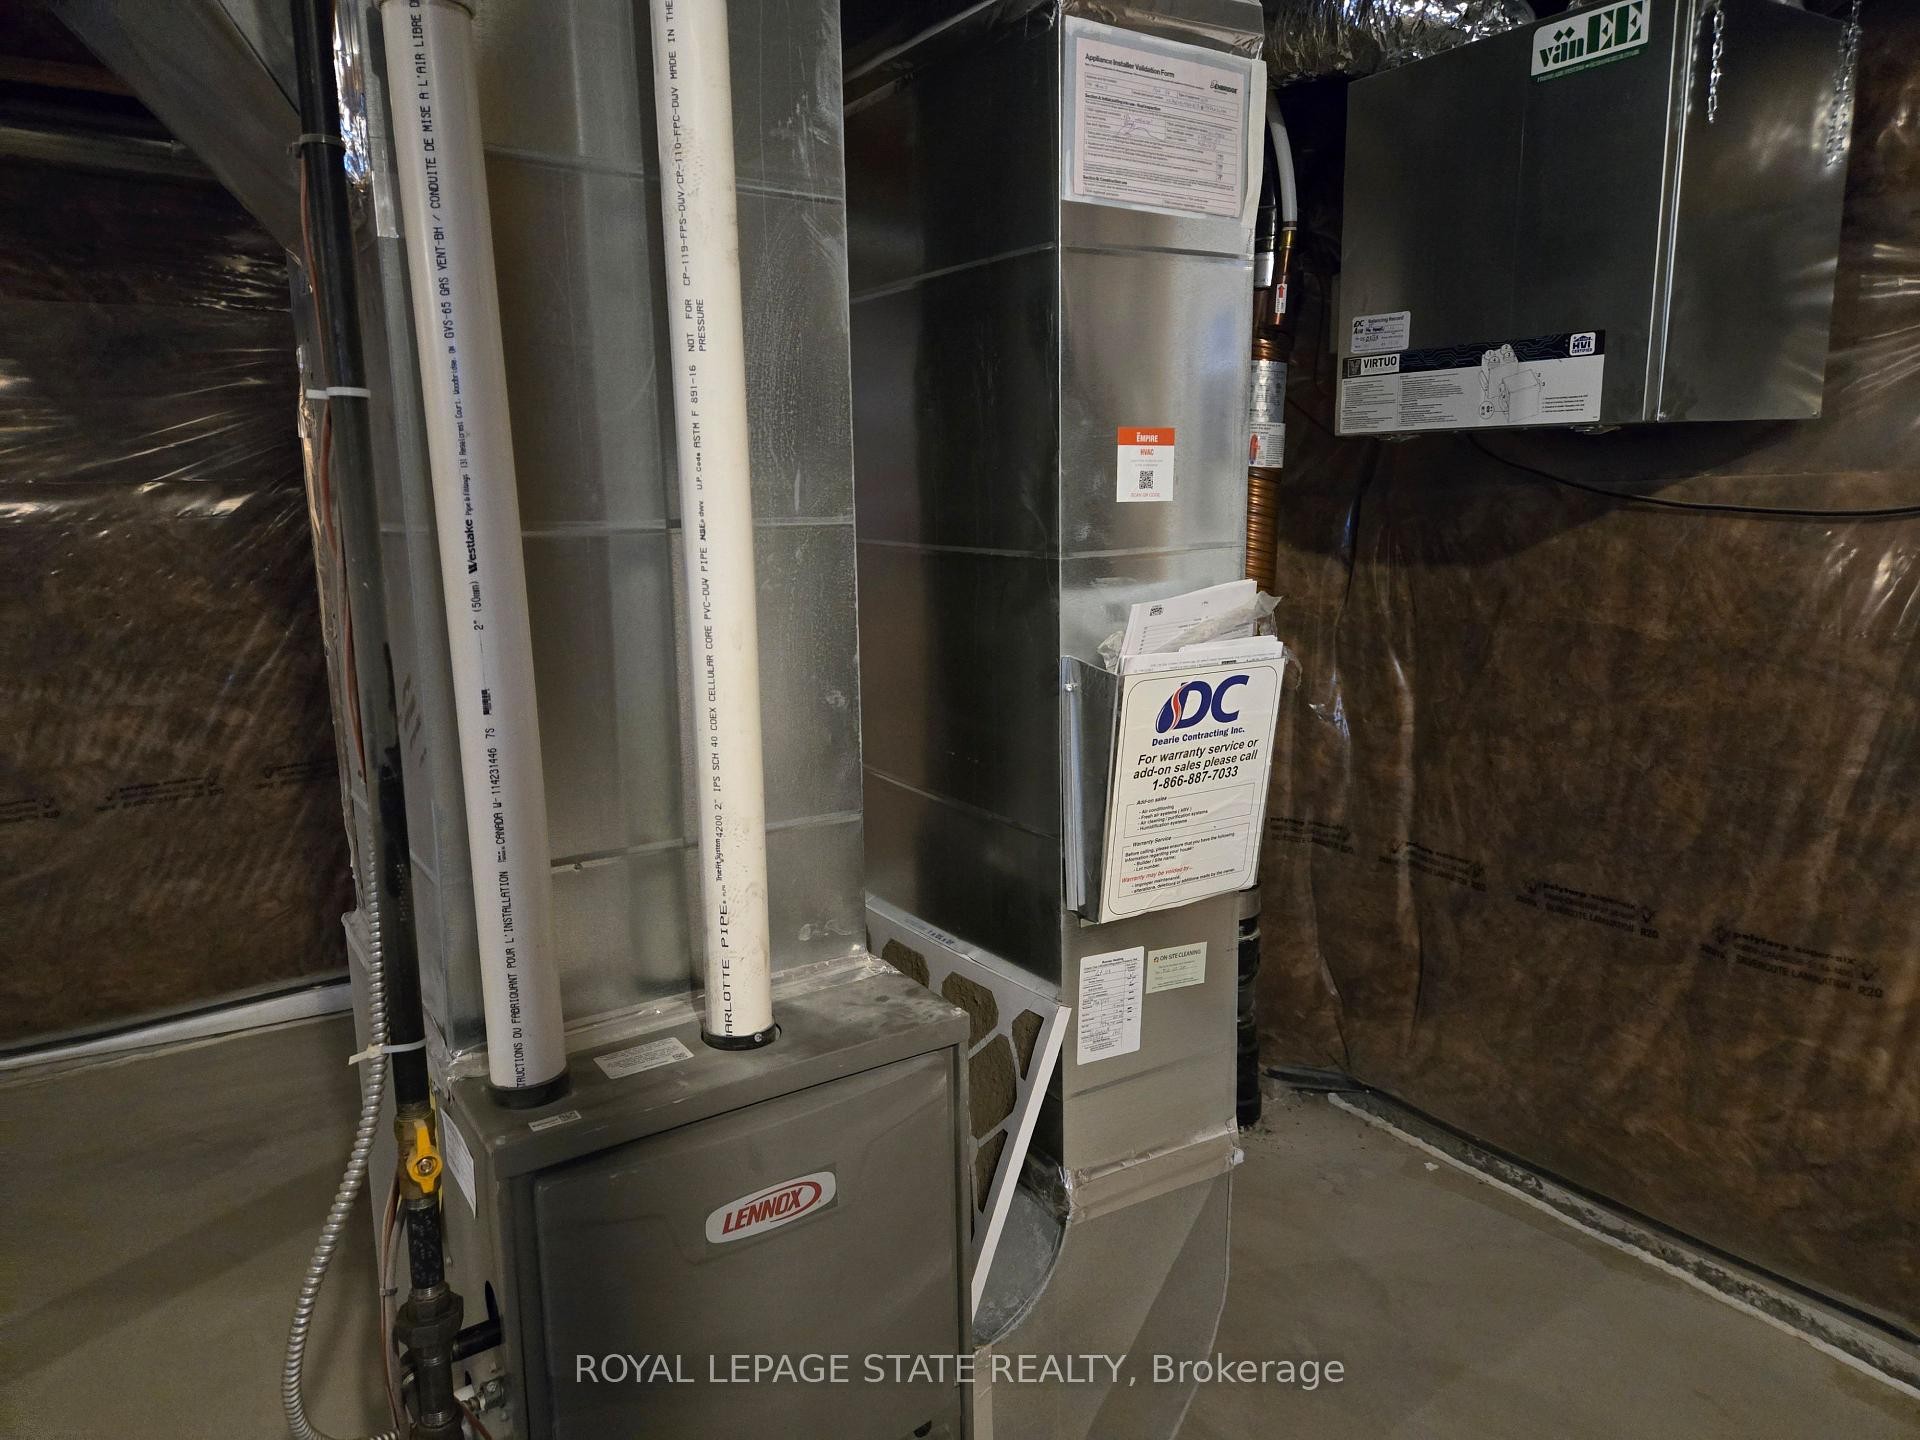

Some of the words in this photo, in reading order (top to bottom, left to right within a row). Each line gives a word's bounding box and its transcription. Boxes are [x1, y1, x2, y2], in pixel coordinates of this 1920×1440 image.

[664, 0, 675, 22] THE
[409, 14, 425, 48] LIBRE
[666, 28, 676, 43] IN
[414, 52, 429, 87] L'AIR
[668, 51, 679, 80] MADE
[1084, 53, 1113, 66] Appliance
[1112, 58, 1135, 70] Installer
[1135, 63, 1161, 75] Validation
[1160, 68, 1175, 79] Form
[418, 89, 430, 100] A
[419, 105, 432, 133] MISE
[423, 137, 435, 152] DE
[425, 157, 442, 209] CONDUITE
[433, 215, 442, 223] /
[433, 225, 449, 271] VENT-BH
[439, 276, 451, 297] GAS
[441, 301, 455, 339] GVS-65
[685, 298, 693, 320] FOR
[695, 298, 708, 352] PRESSURE
[686, 332, 696, 352] NOT
[1572, 340, 1591, 350] HVI
[1363, 356, 1398, 370] VIRTUO
[688, 364, 699, 404] 891-16
[691, 422, 702, 449] ASTM
[1136, 432, 1159, 443] EMPIRE
[1140, 448, 1155, 456] HVAC
[464, 518, 478, 575] Westlake
[699, 547, 709, 572] PIPE
[700, 577, 713, 621] PVC-DWV
[703, 625, 714, 650] CORE
[705, 654, 717, 703] CELLULAR
[708, 706, 719, 731] COEX
[711, 735, 719, 748] 40
[1151, 734, 1180, 747] Dearie
[1182, 726, 1229, 742] Contracting
[1230, 725, 1246, 735] Inc.
[711, 752, 721, 771] SCH
[1137, 754, 1156, 766] For
[1159, 747, 1206, 762] warranty
[1208, 741, 1245, 755] service
[1247, 738, 1259, 749] or
[1133, 764, 1171, 780] add-on
[1174, 760, 1201, 774] sales
[1203, 756, 1238, 771] please
[1239, 750, 1258, 763] call
[712, 775, 722, 793] IPS
[1152, 765, 1240, 792] 1-866-887-7033
[1137, 797, 1154, 805] Add-on
[1149, 804, 1174, 812] conditioning
[494, 812, 507, 845] CANADA
[714, 814, 724, 839] 4200
[1133, 839, 1153, 848] Warranty
[1122, 874, 1145, 883] Warranty
[1147, 872, 1157, 880] may
[499, 871, 515, 943] L'INSTALLATION
[718, 903, 730, 949] PIPE
[505, 947, 516, 969] POUR
[507, 973, 521, 1024] FABRIQUANT
[513, 1027, 523, 1039] DU
[721, 1186, 804, 1235] LENNOX
